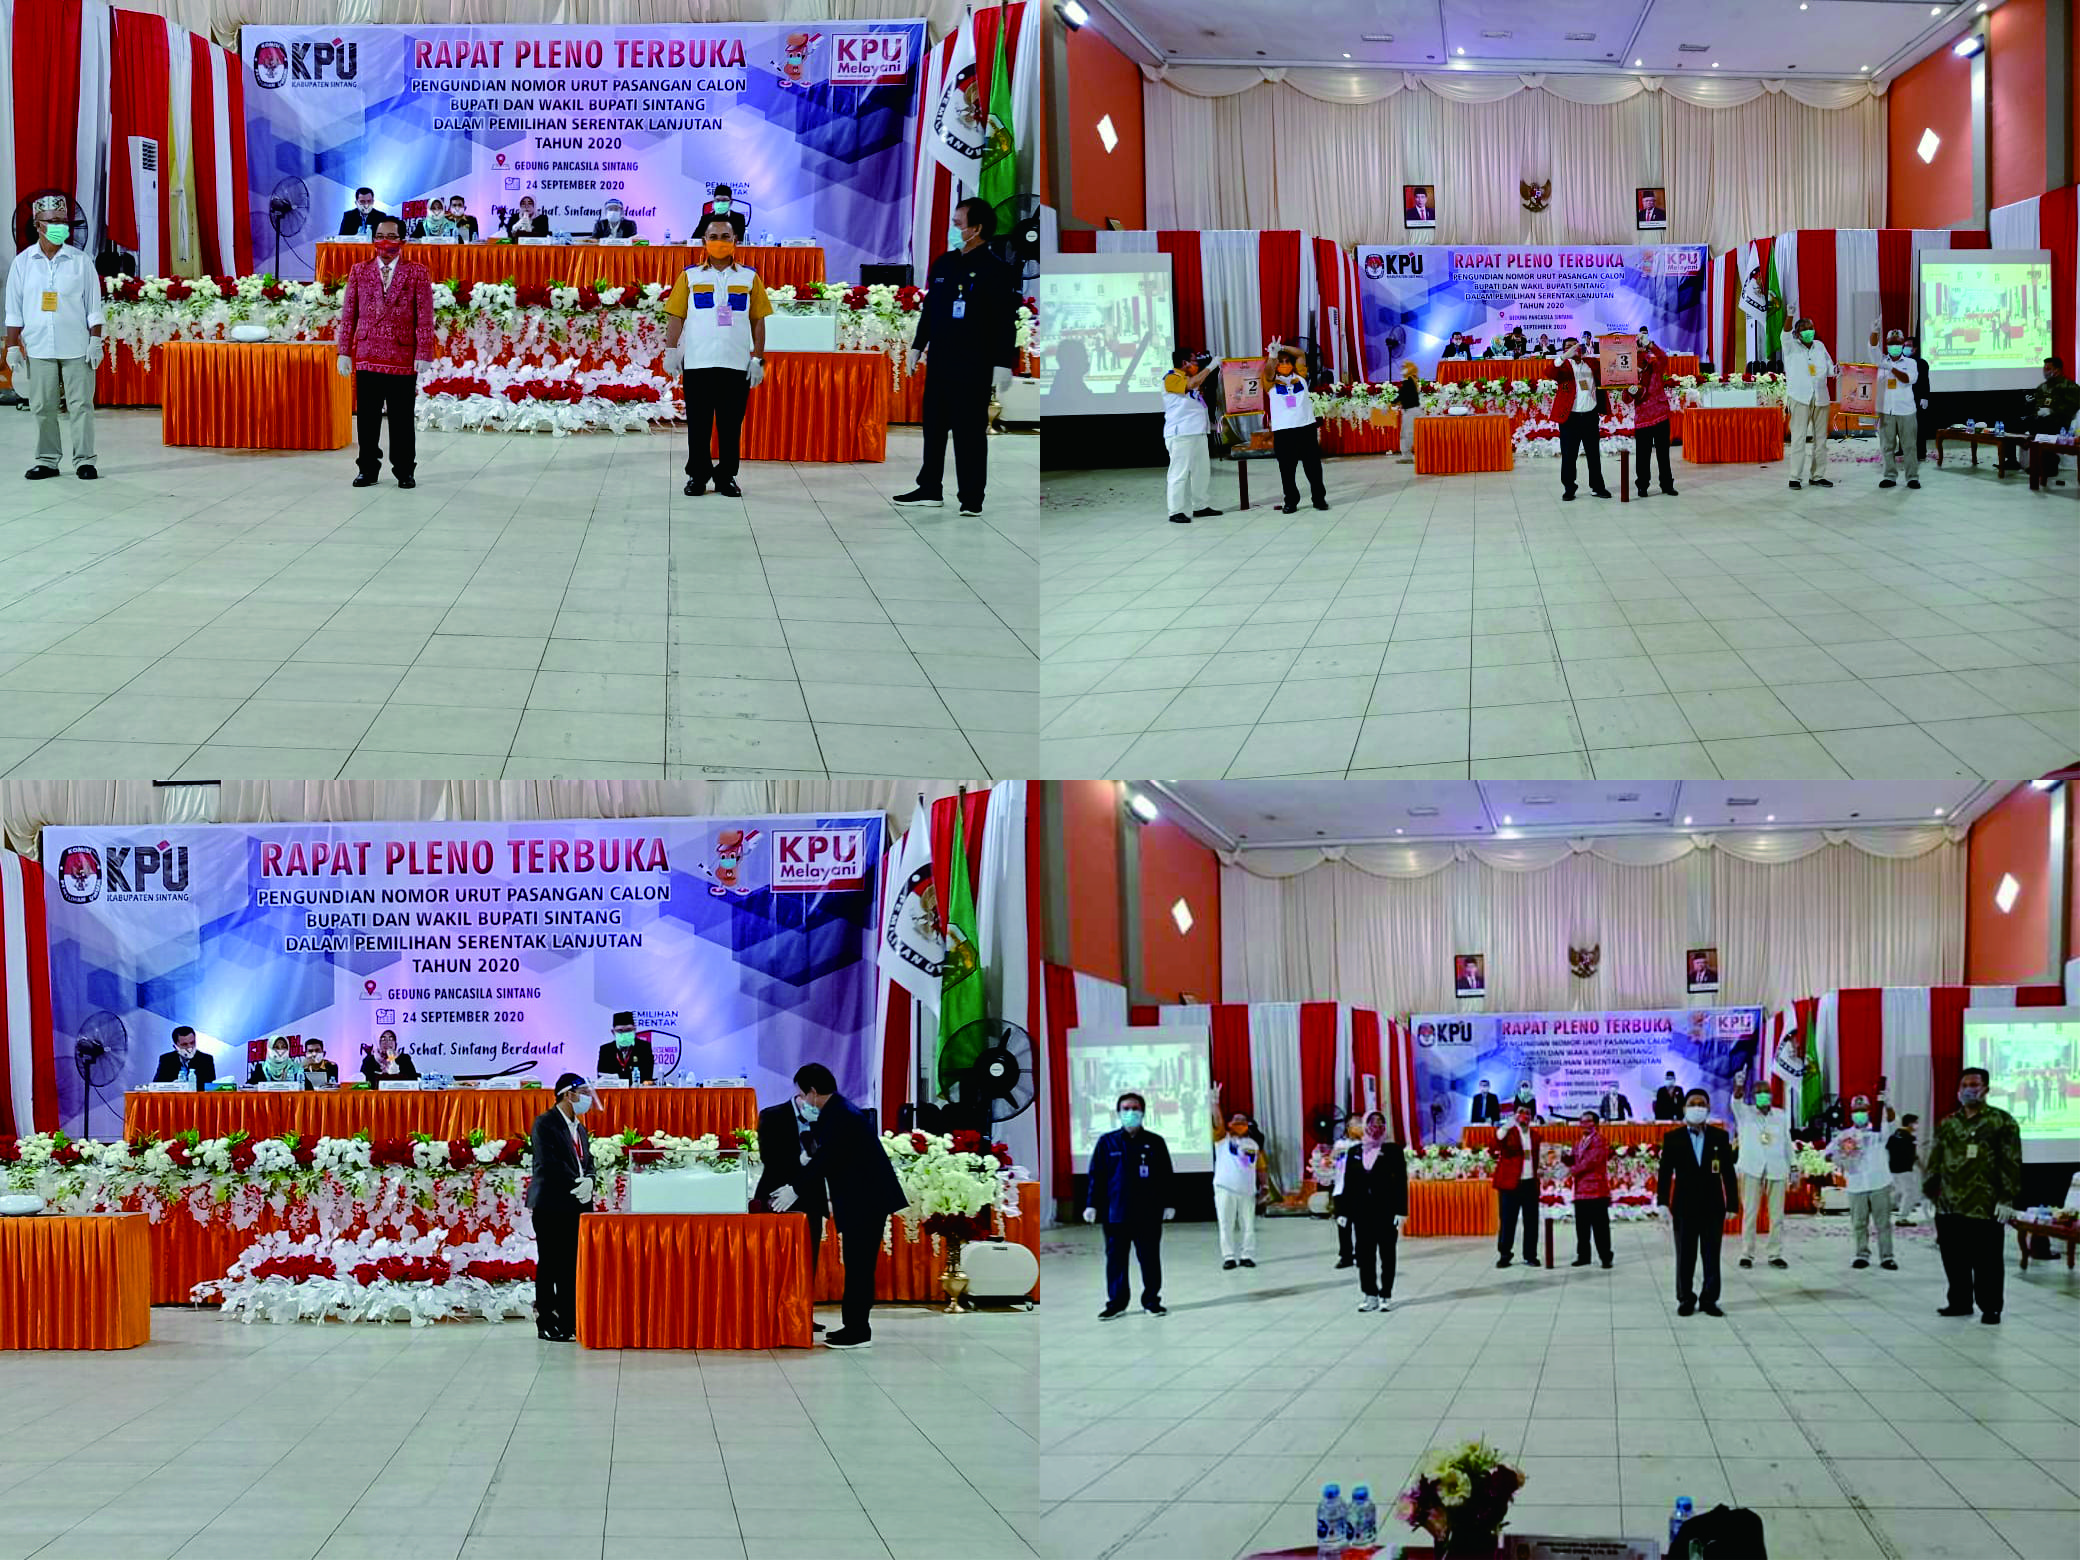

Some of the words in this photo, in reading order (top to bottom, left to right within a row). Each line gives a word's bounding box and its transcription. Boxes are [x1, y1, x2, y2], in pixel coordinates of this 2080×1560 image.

[414, 39, 505, 70] RAPAT
[515, 39, 604, 69] PLENO
[614, 38, 747, 68] TERBUKA
[838, 38, 902, 61] KPU
[292, 37, 357, 80] KPU
[837, 60, 901, 77] Melayani
[412, 79, 506, 92] PENGUNDIAN
[511, 79, 566, 92] NOMOR
[570, 79, 608, 92] URUT
[612, 78, 692, 92] PASANGAN
[696, 78, 747, 92] CALON
[450, 98, 499, 111] BUPATI
[503, 98, 534, 111] DAN
[538, 98, 585, 111] WAKIL
[589, 98, 640, 111] BUPATI
[642, 98, 706, 111] SINTANG
[433, 117, 484, 130] DALAM
[489, 117, 567, 130] PEMILIHAN
[572, 117, 644, 130] SERENTAK
[648, 117, 723, 131] LANJUTAN
[535, 136, 582, 149] TAHUN
[587, 136, 622, 150] 2020
[514, 160, 549, 172] GEDUNG
[552, 160, 600, 171] PANCASILA
[602, 160, 639, 172] SINTANG
[525, 179, 537, 191] 24
[541, 179, 597, 191] SEPTEMBER
[600, 179, 625, 191] 2020
[1386, 251, 1423, 275] KPU
[1454, 253, 1501, 269] RAPAT
[1507, 253, 1553, 269] PLENO
[1558, 252, 1625, 268] TERBUKA
[1667, 252, 1699, 264] KPU
[1453, 273, 1504, 281] PENGUNDIAN
[1600, 272, 1625, 280] CALON
[1546, 282, 1572, 290] BUPATI
[1573, 282, 1606, 290] SINTANG
[1537, 292, 1576, 300] SERENTAK
[1577, 292, 1614, 300] LANJUTAN
[1519, 302, 1544, 310] TAHUN
[1620, 355, 1629, 366] 3
[1248, 380, 1258, 392] 2
[1861, 384, 1867, 396] 1
[779, 835, 856, 863] KPU
[261, 841, 371, 878] RAPAT
[385, 839, 494, 877] PLENO
[507, 837, 670, 876] TERBUKA
[106, 839, 189, 893] KPU
[780, 861, 857, 881] Melayani
[106, 894, 153, 902] KABUPATEN
[155, 893, 189, 902] SINTANG
[258, 889, 376, 905] PENGUNDIAN
[381, 888, 450, 904] NOMOR
[456, 887, 503, 903] URUT
[507, 886, 604, 902] PASANGAN
[609, 885, 670, 901] CALON
[306, 912, 366, 928] BUPATI
[372, 912, 411, 927] DAN
[416, 911, 473, 927] WAKIL
[478, 911, 539, 927] BUPATI
[543, 909, 621, 926] SINTANG
[286, 936, 349, 952] DALAM
[354, 935, 452, 951] PEMILIHAN
[457, 934, 547, 950] SERENTAK
[552, 933, 643, 949] LANJUTAN
[412, 958, 472, 974] TAHUN
[478, 957, 520, 974] 2020
[388, 987, 430, 1001] GEDUNG
[434, 986, 494, 1001] PANCASILA
[496, 986, 542, 1000] SINTANG
[402, 1011, 417, 1024] 24
[421, 1010, 490, 1024] SEPTEMBER
[494, 1010, 525, 1023] 2020
[632, 1010, 679, 1018] EMILIHAN
[634, 1019, 677, 1027] ERENTAK
[1502, 1020, 1549, 1036] RAPAT
[1553, 1019, 1600, 1035] PLENO
[1605, 1017, 1673, 1034] TERBUKA
[1437, 1020, 1472, 1043] KPU
[450, 1042, 497, 1062] Sintang
[501, 1041, 566, 1056] Berdaulat
